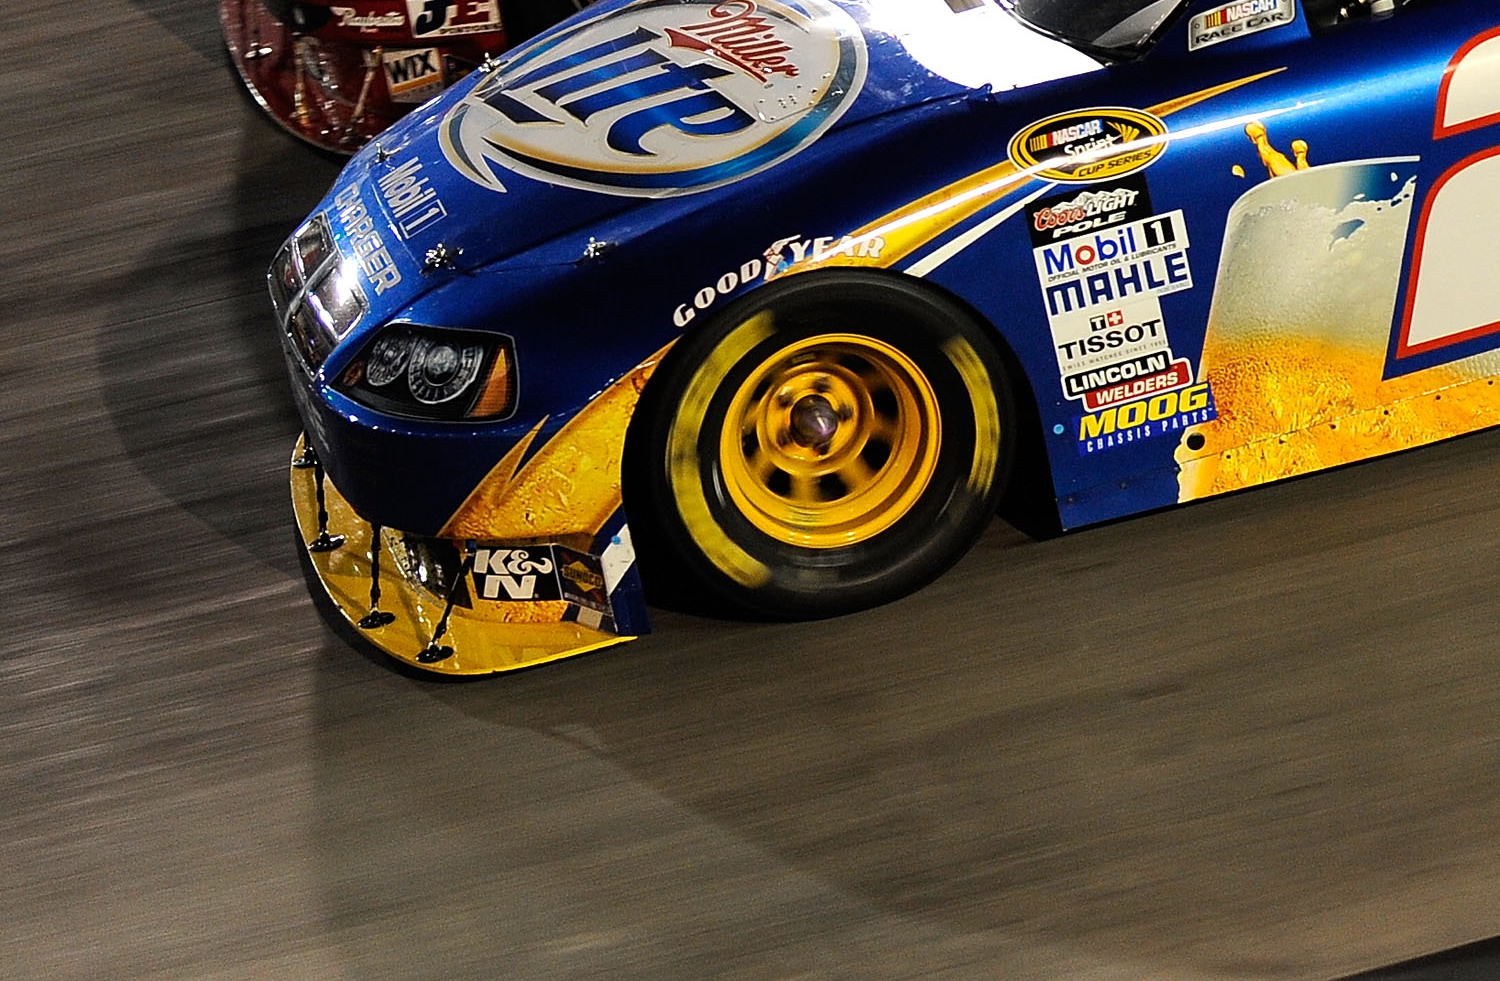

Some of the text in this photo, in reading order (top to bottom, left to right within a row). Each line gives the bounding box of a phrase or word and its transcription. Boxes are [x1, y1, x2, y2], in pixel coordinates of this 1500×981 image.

[1195, 12, 1284, 44] RACE CAR
[387, 50, 437, 84] WIX
[1052, 119, 1104, 146] NASCAR
[1078, 150, 1152, 177] CUP SERIES
[378, 156, 437, 218] Mobil
[1085, 191, 1140, 218] LIGHT
[334, 182, 402, 297] CHARGER
[1052, 211, 1127, 238] POLE
[1043, 226, 1137, 275] Mobil
[1047, 269, 1080, 283] OFFICIAL
[1082, 261, 1109, 273] MOTOR
[1131, 243, 1177, 260] LUBRICANTS
[673, 234, 886, 328] GOODYEAR
[1047, 252, 1189, 316] MAHLE
[1058, 319, 1162, 360] TISSOT
[1069, 354, 1166, 393] LINCOLN
[1096, 371, 1179, 406] WELDERS
[1079, 383, 1209, 442] MOOG
[1086, 409, 1208, 453] CHASSIS PARTS
